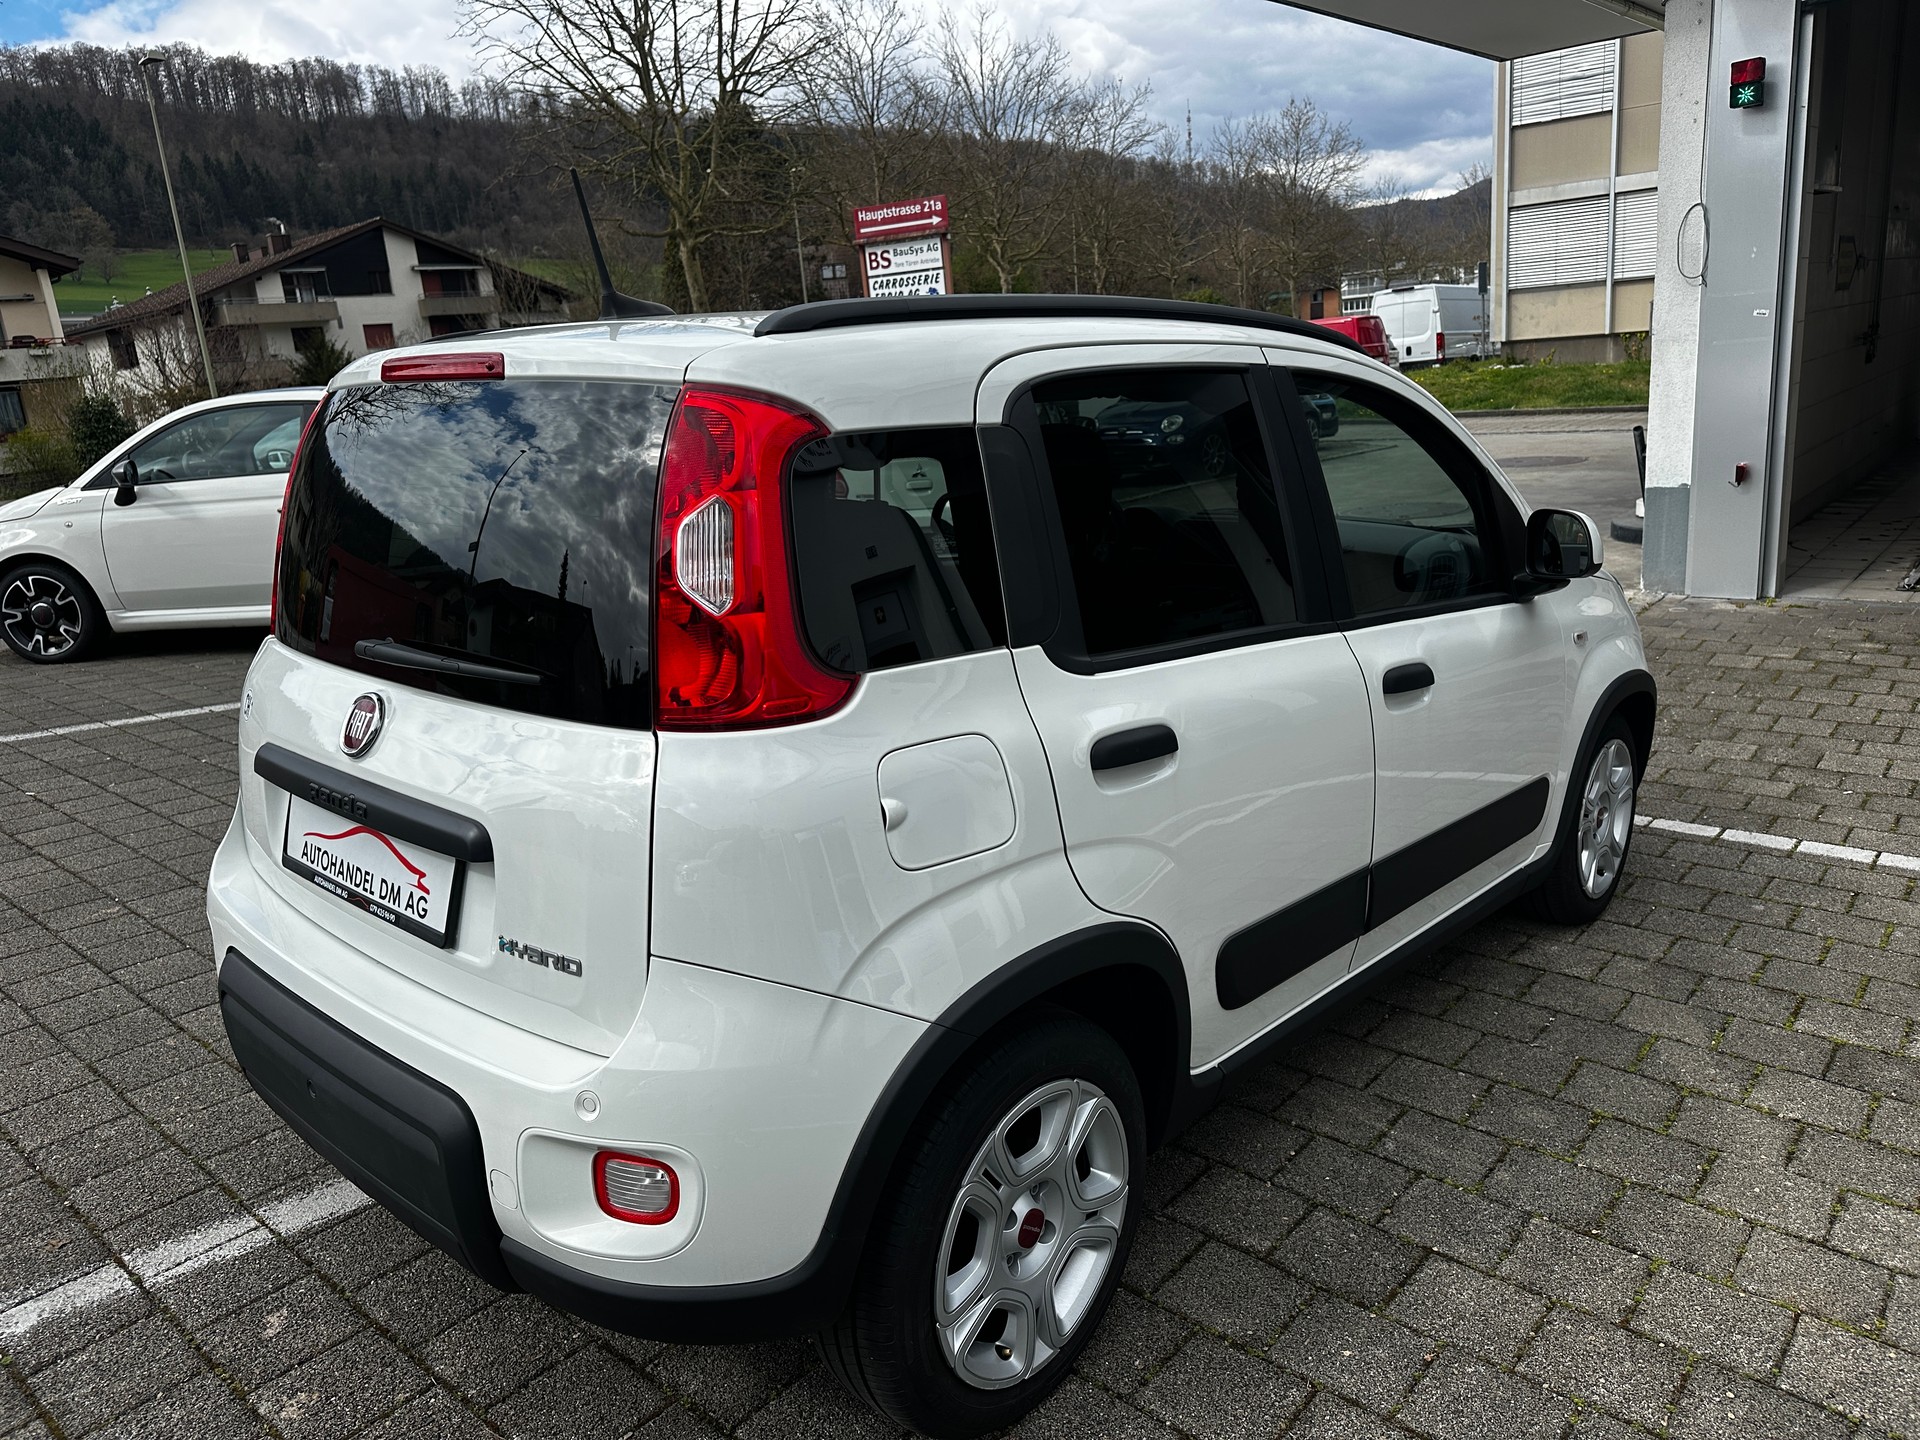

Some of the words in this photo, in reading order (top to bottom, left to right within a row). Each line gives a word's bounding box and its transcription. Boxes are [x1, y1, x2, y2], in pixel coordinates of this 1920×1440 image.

[858, 204, 921, 221] Hauptstrasse
[923, 200, 942, 212] 21a
[868, 249, 892, 271] BS
[893, 245, 924, 257] BauSys
[926, 242, 939, 253] AG
[872, 272, 941, 291] CARROSSERIE
[346, 709, 374, 740] FIAT
[301, 841, 375, 896] AUTOHANDEL
[378, 877, 401, 909] DM
[404, 890, 429, 920] AG
[499, 935, 582, 978] HYBRID
